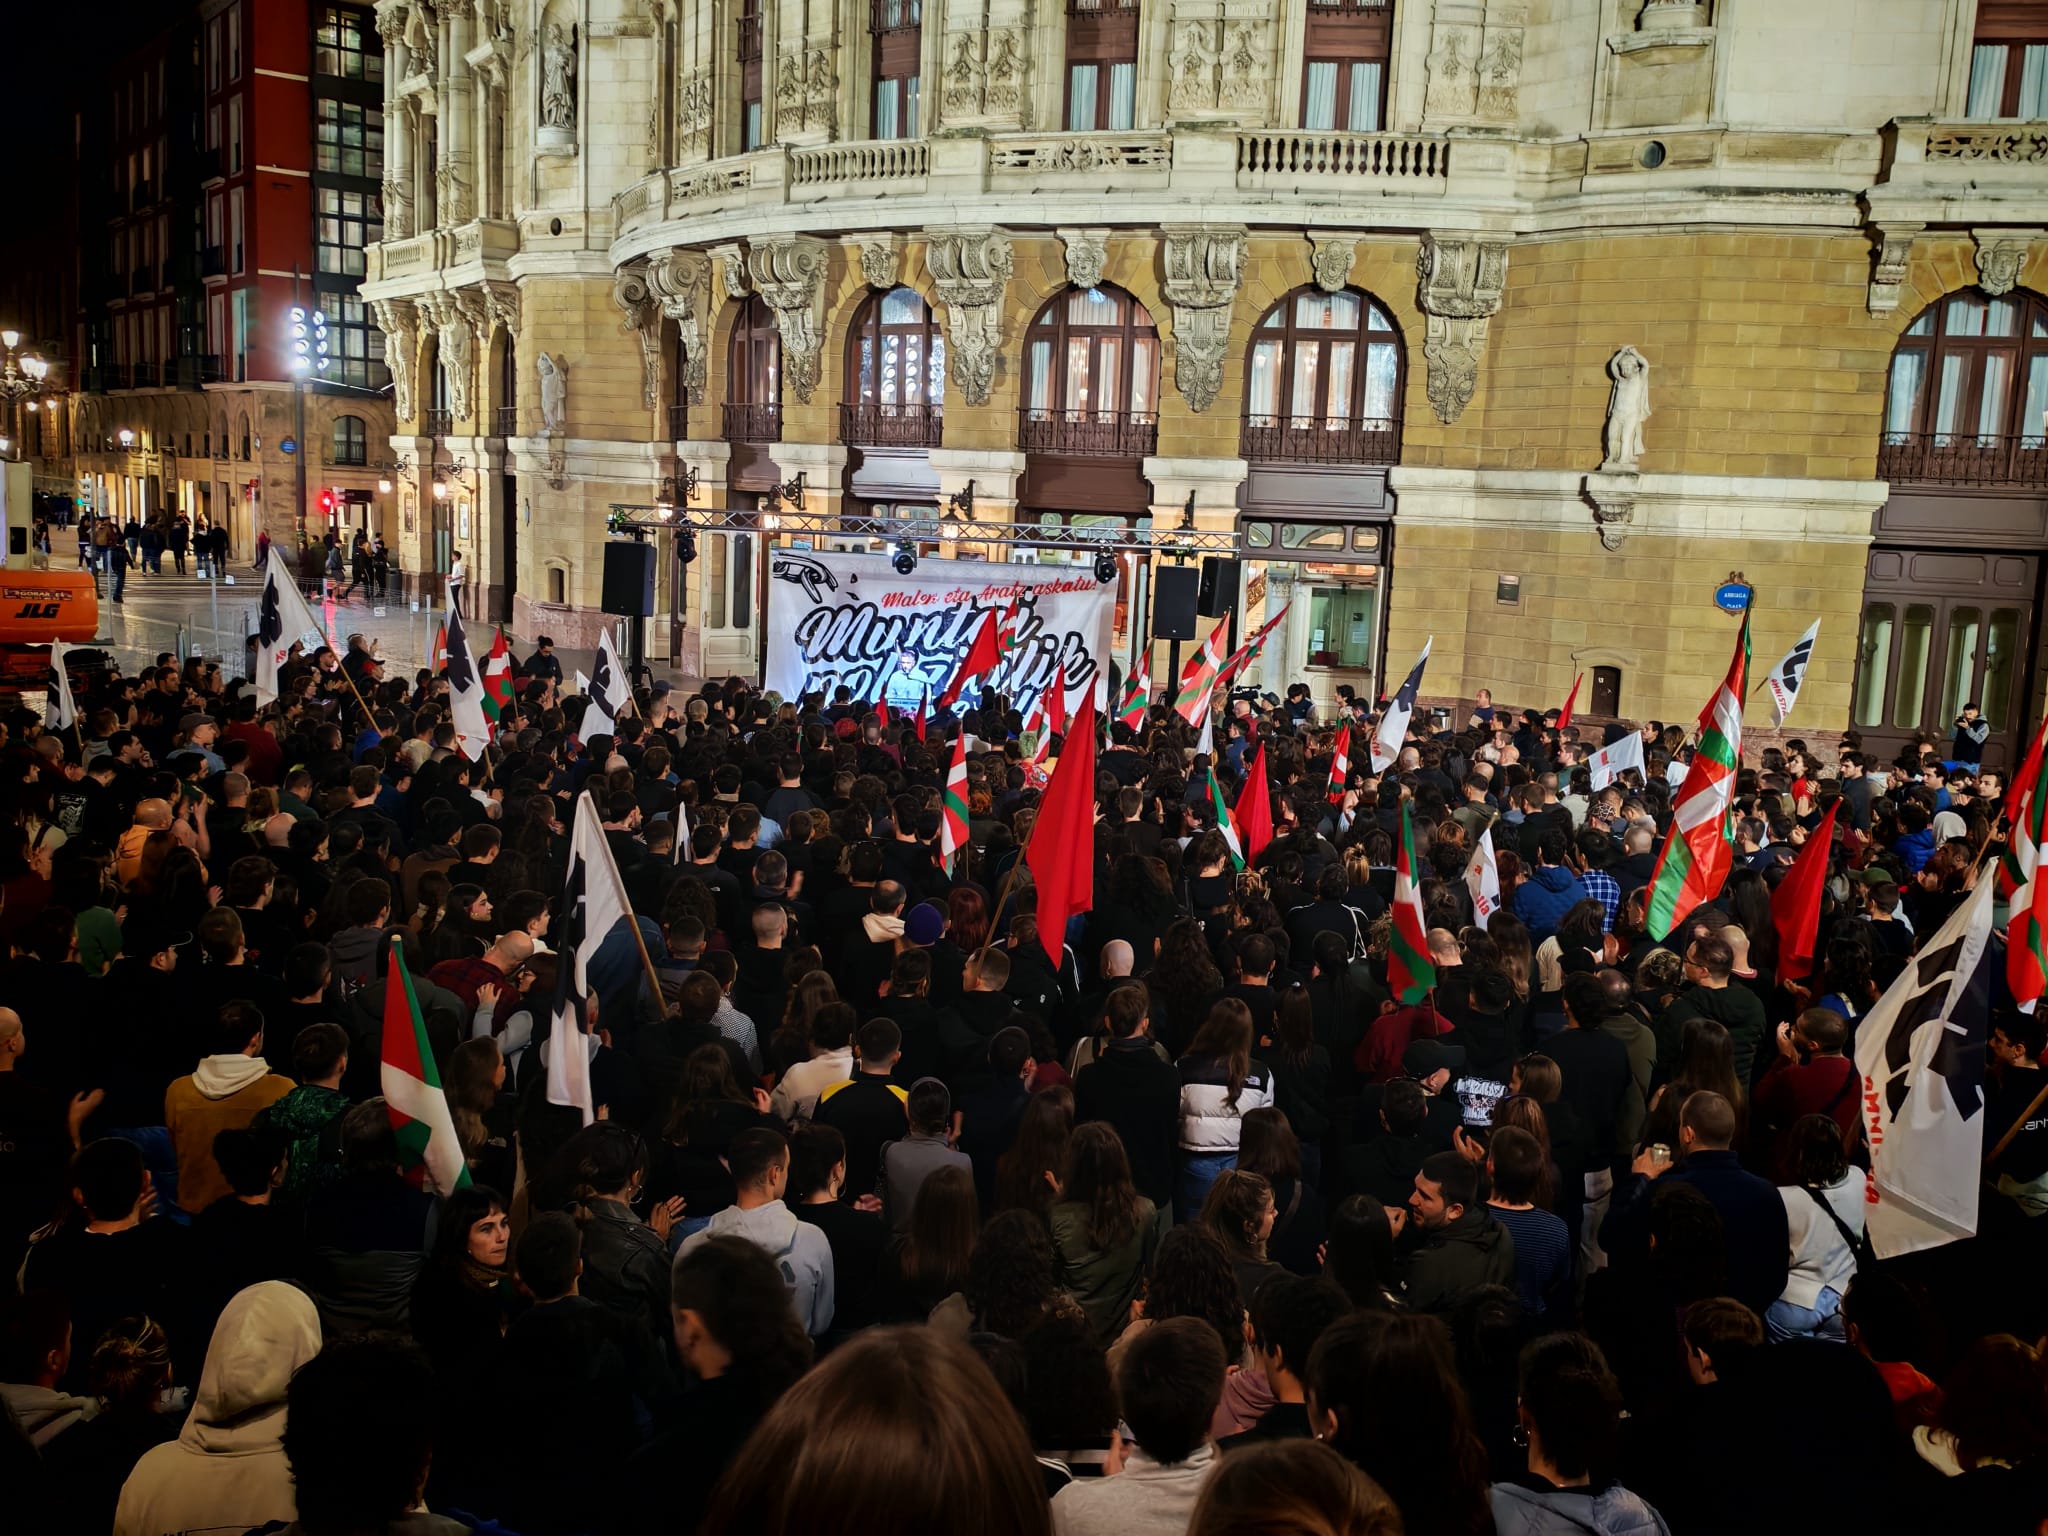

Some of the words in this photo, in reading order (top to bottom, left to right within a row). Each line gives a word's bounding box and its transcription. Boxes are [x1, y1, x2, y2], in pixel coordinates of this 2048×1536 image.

[944, 587, 972, 604] eta
[1032, 575, 1098, 596] askatu!
[14, 602, 60, 619] JLG
